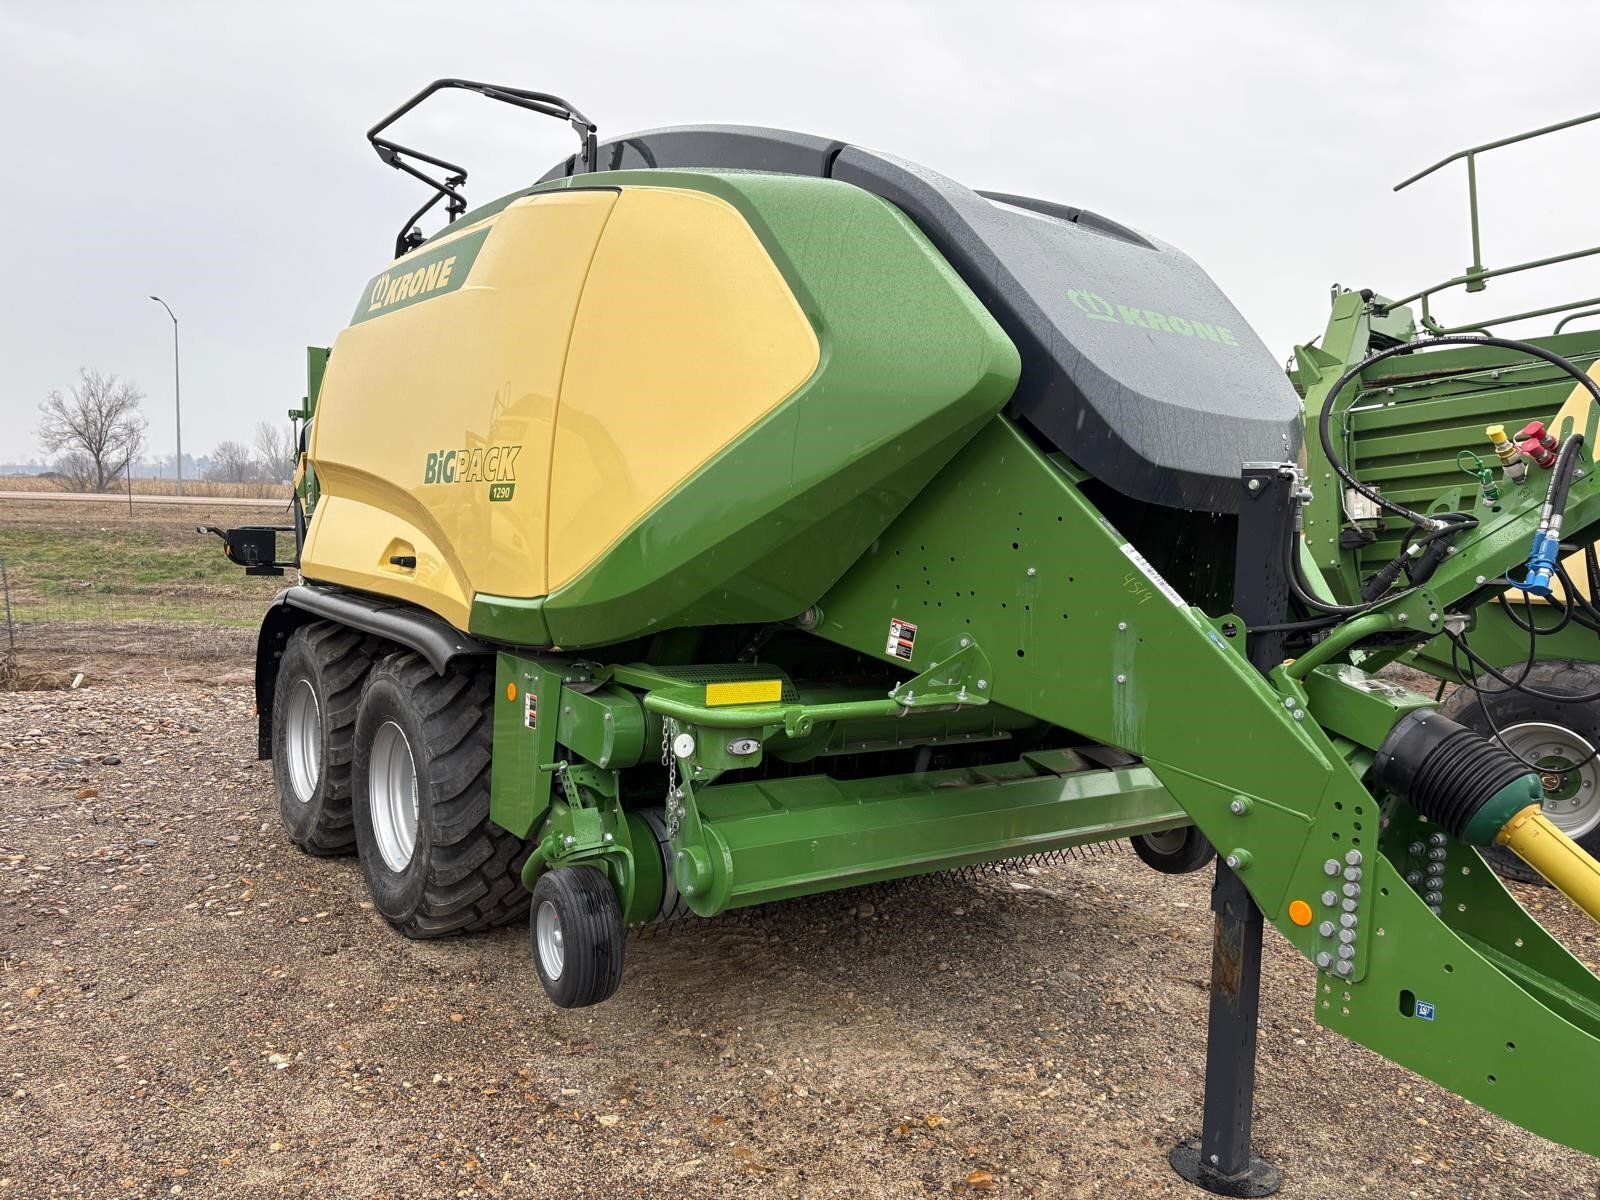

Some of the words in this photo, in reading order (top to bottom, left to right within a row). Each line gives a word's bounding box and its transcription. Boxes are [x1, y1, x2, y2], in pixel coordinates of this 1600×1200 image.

[385, 256, 457, 306] KRONE
[1116, 304, 1240, 347] KRONE
[492, 487, 511, 499] 1290
